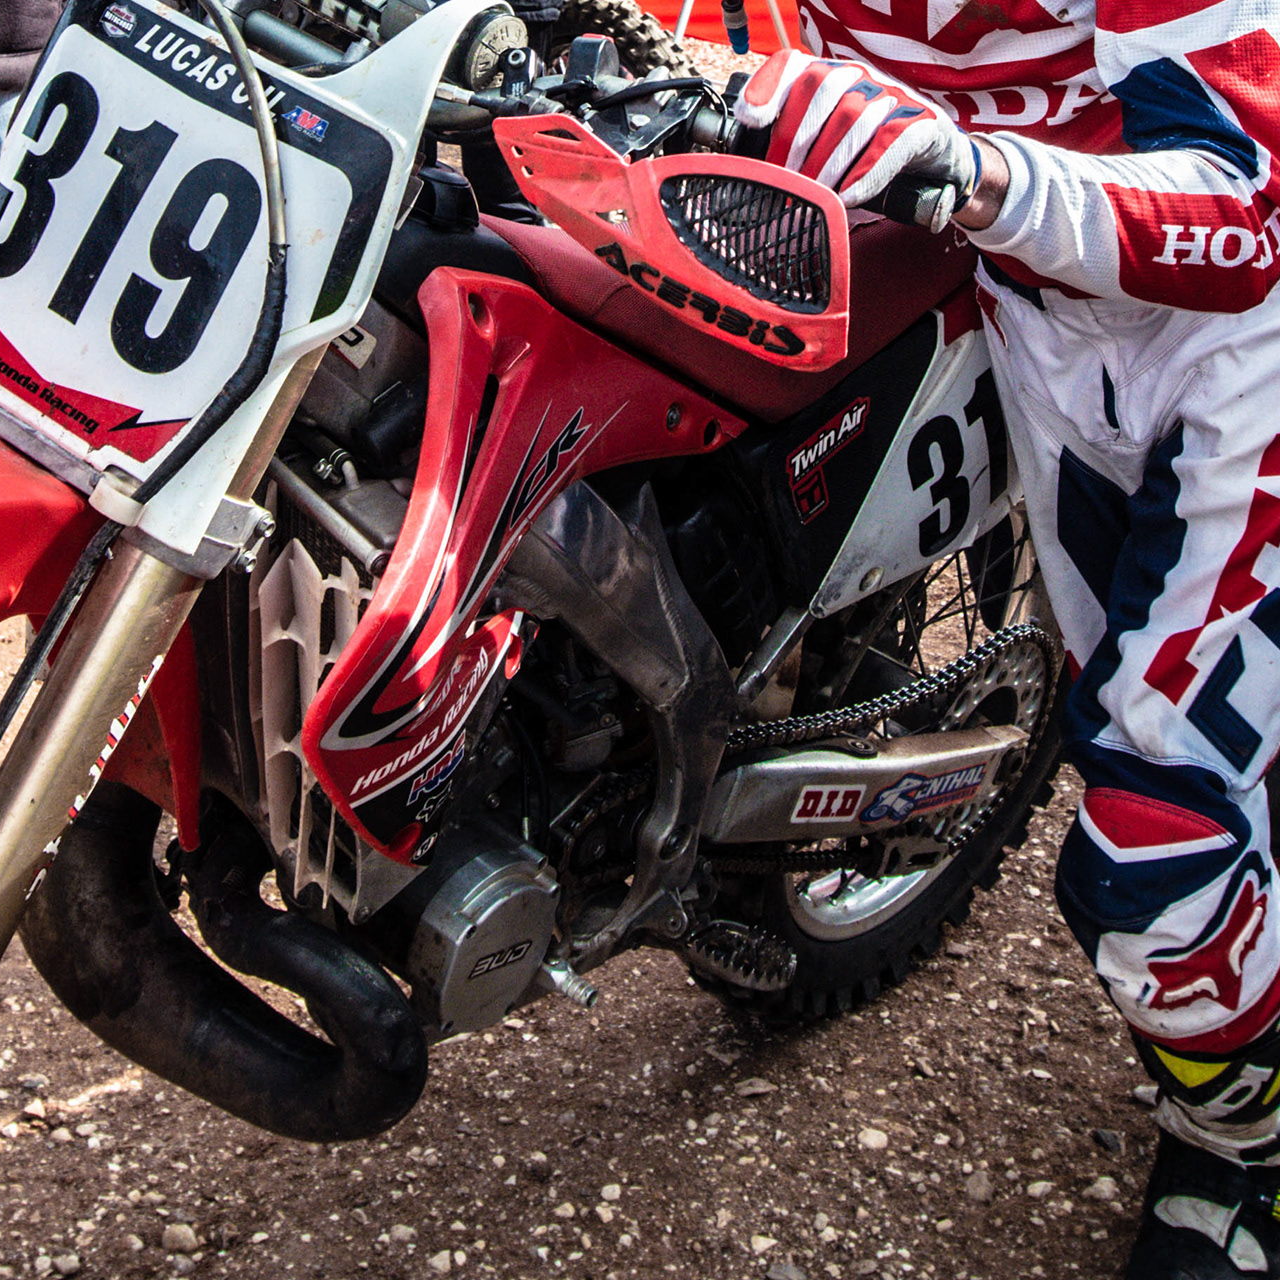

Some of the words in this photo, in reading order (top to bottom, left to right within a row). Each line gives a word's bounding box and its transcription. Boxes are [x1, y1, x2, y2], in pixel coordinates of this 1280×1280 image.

[133, 24, 237, 91] LUCAS
[281, 106, 329, 138] AMA
[38, 383, 99, 435] Racing
[791, 427, 836, 478] Twin
[837, 402, 866, 440] Air
[351, 728, 439, 796] Honda
[443, 645, 490, 730] Racing
[796, 789, 863, 819] D.I.D
